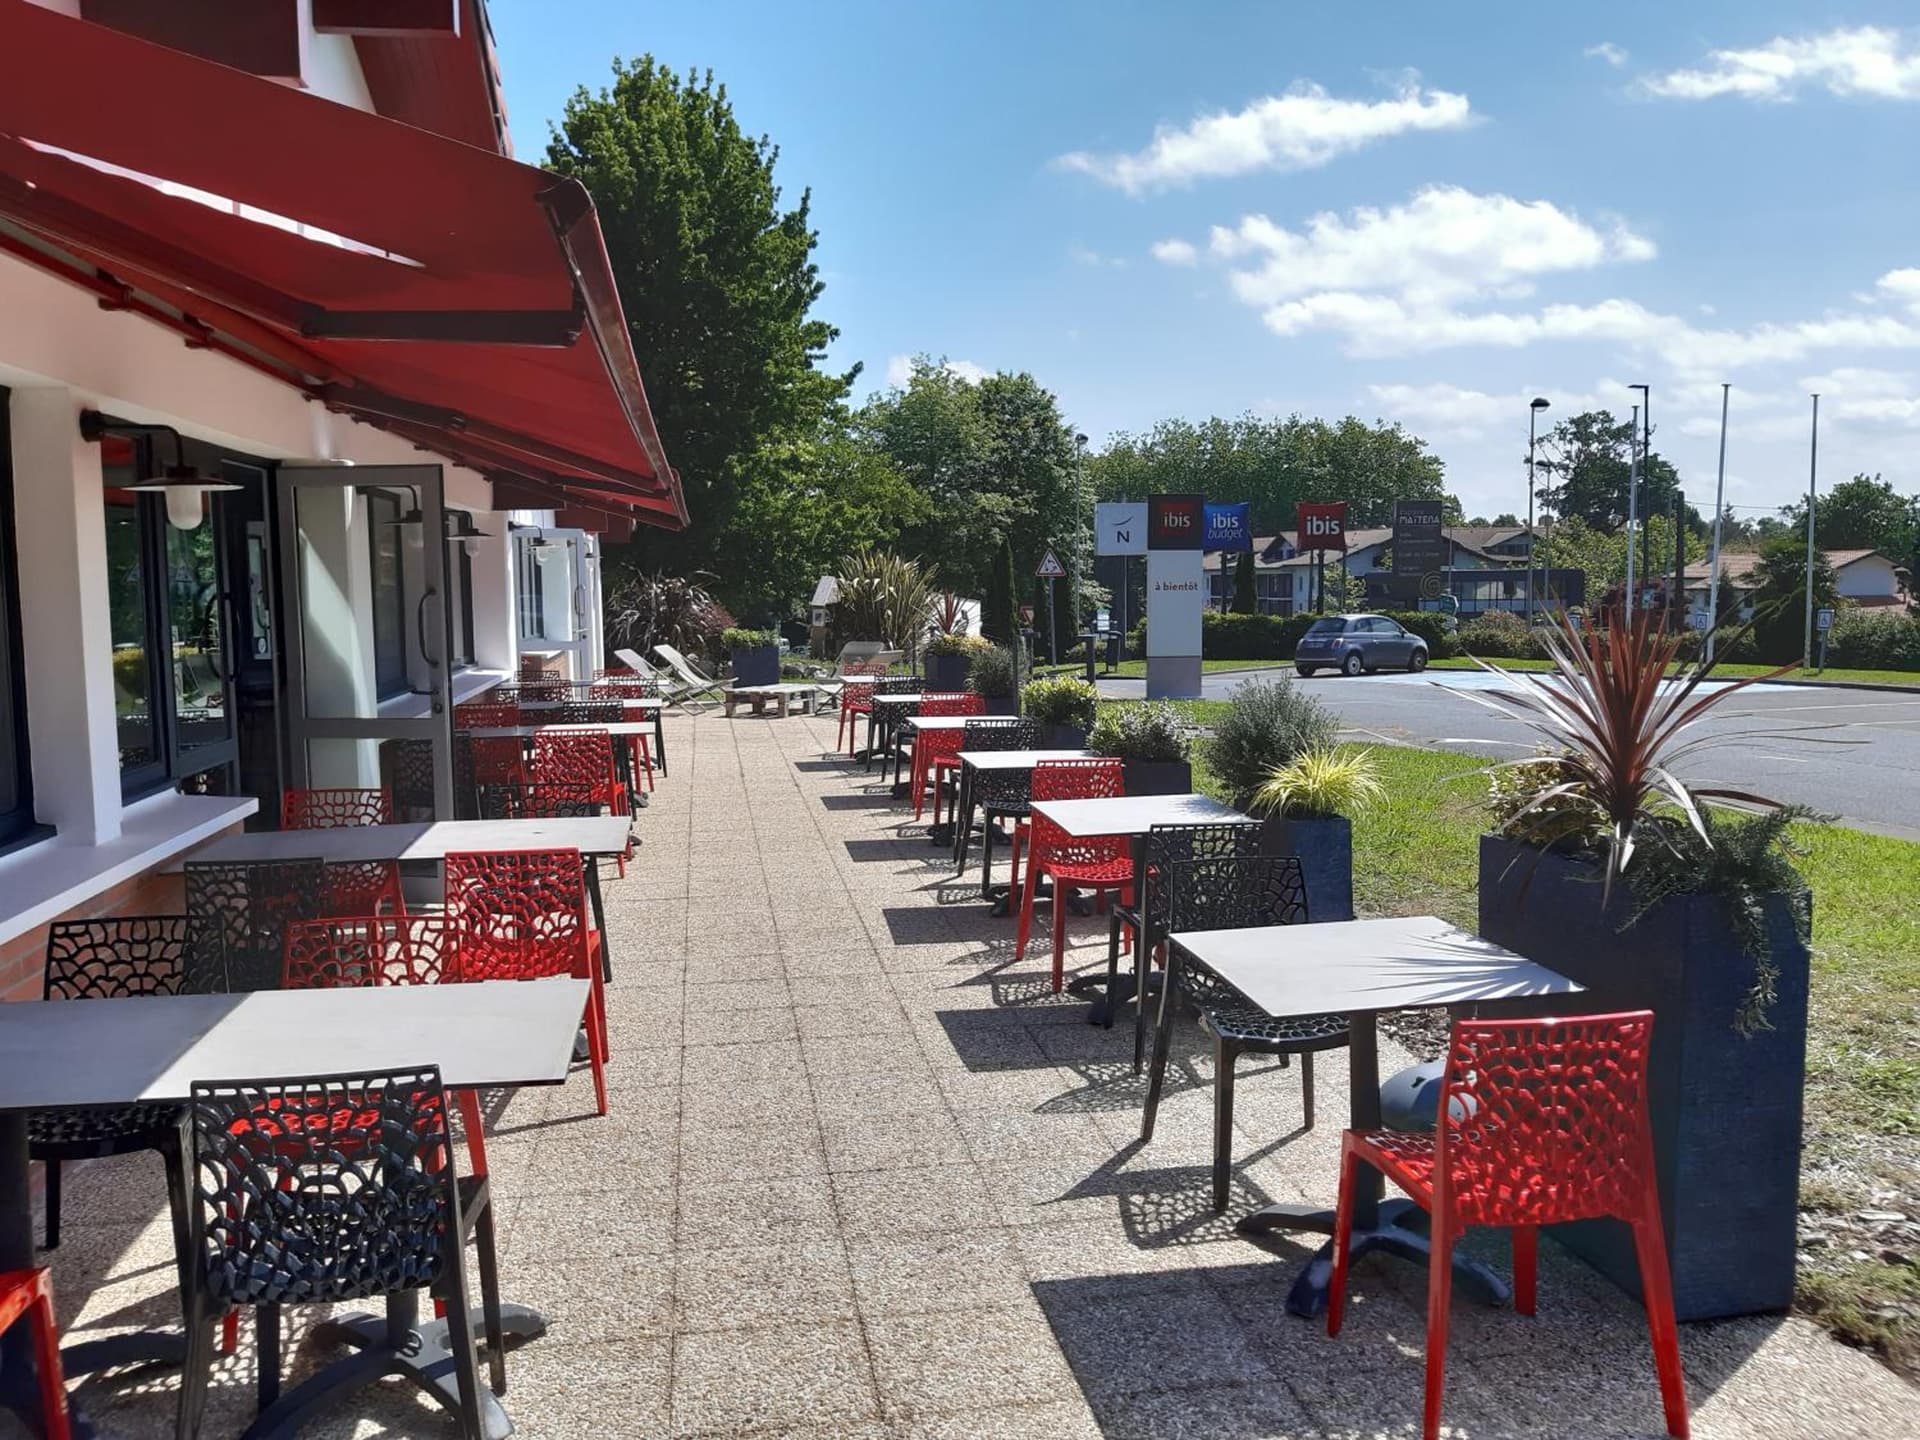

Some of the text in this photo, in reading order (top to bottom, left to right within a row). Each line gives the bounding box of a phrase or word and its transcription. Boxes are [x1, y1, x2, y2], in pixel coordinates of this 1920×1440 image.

[1164, 512, 1191, 527] ibis
[1212, 513, 1239, 528] ibis
[1306, 516, 1340, 535] ibis
[1116, 530, 1129, 543] N
[1207, 527, 1243, 540] budget
[1163, 581, 1198, 591] bientôt
